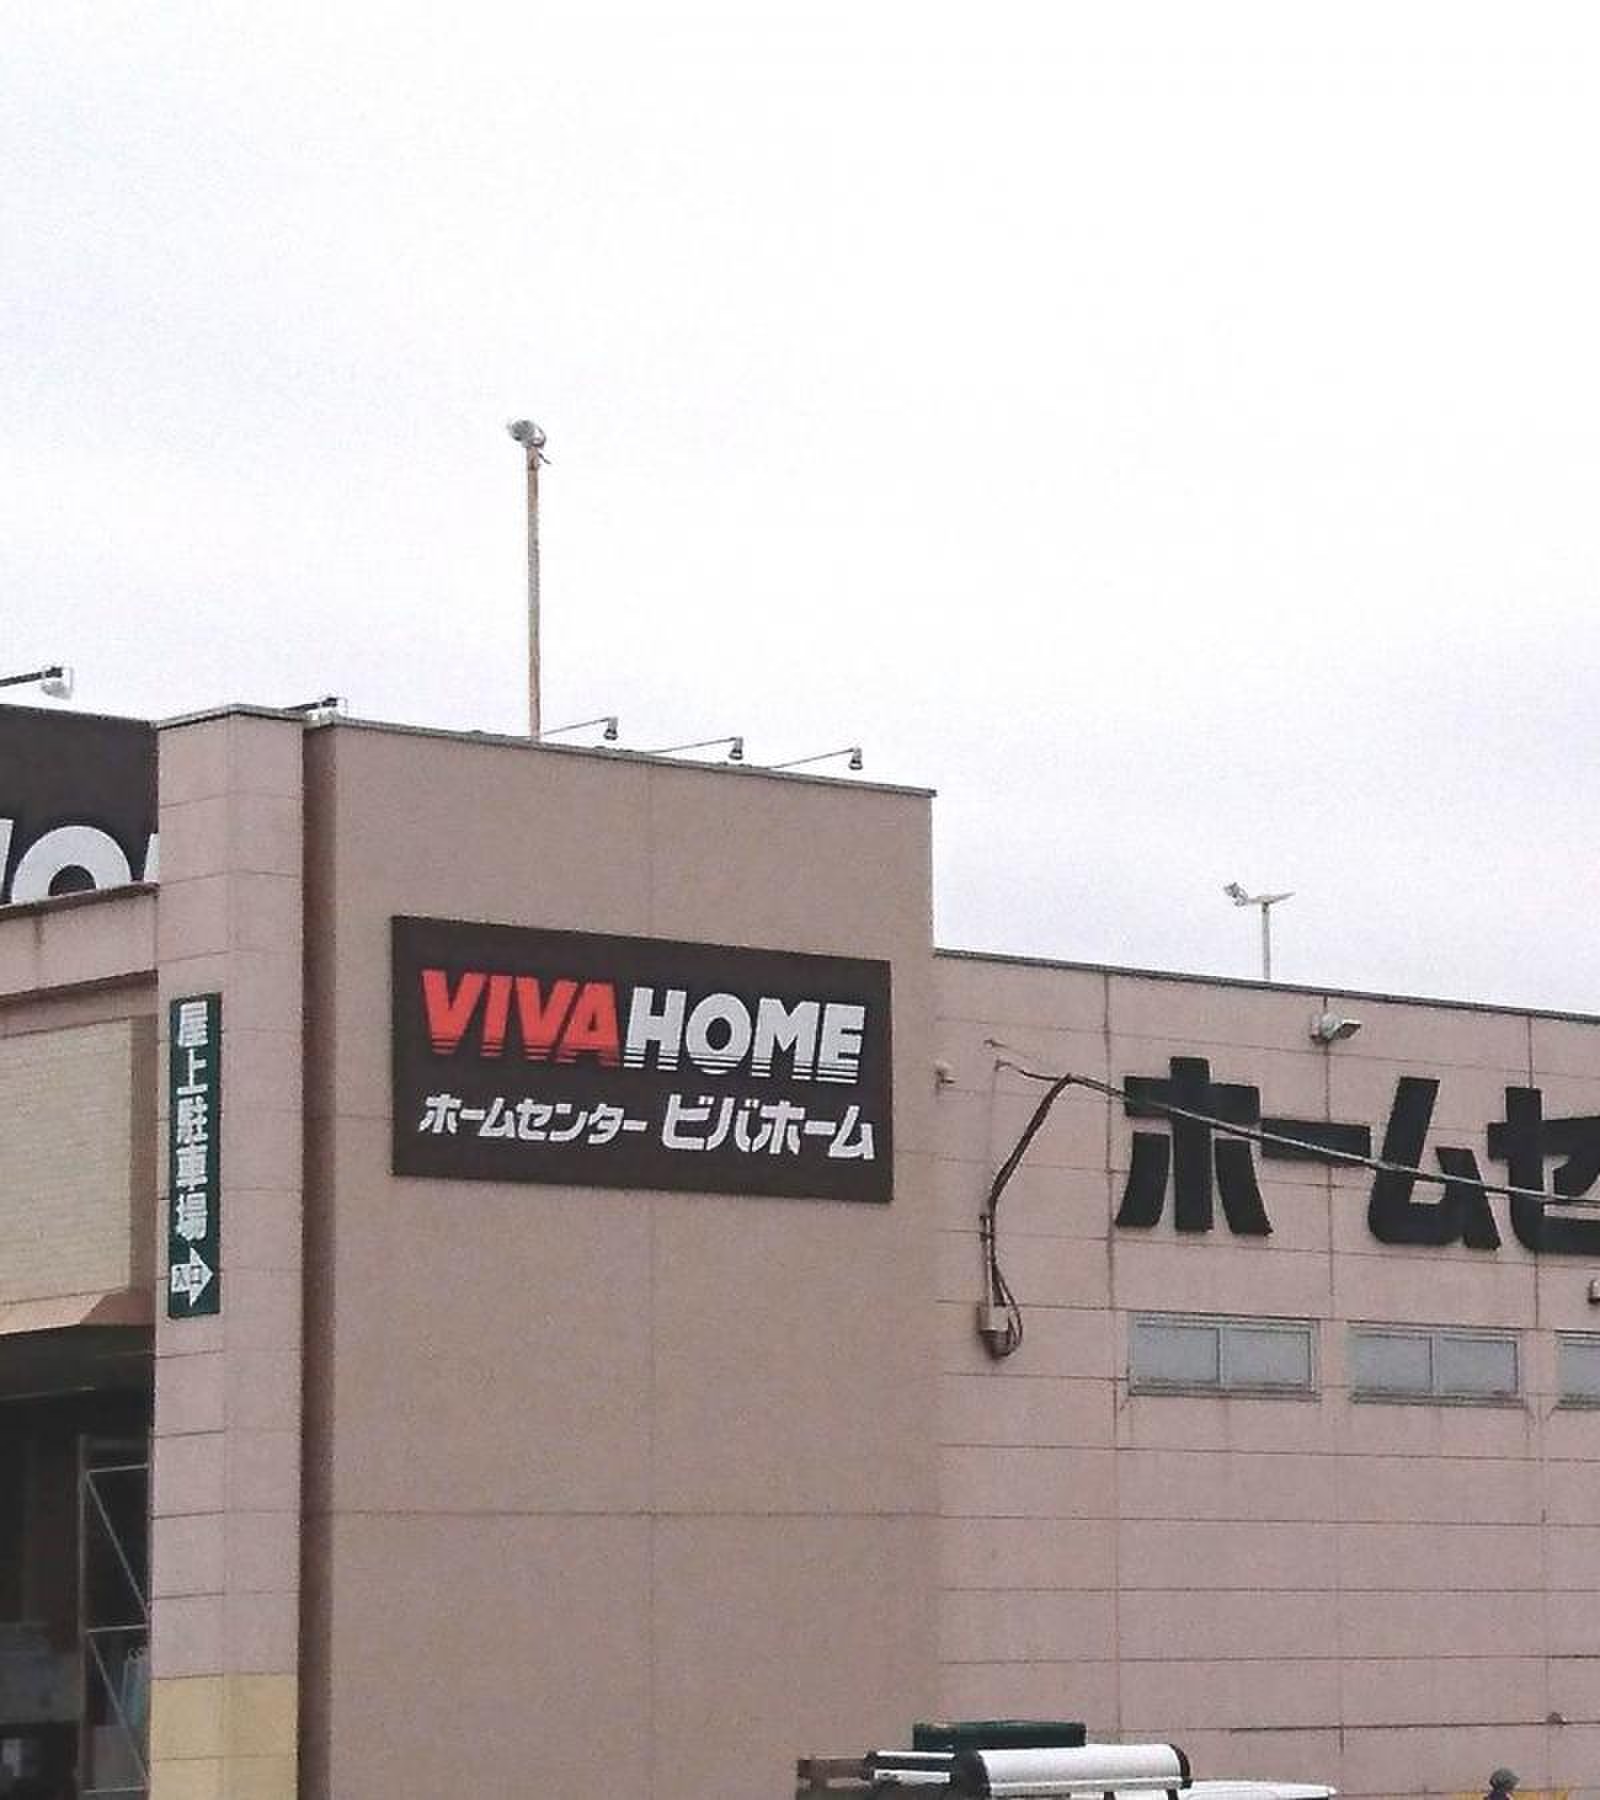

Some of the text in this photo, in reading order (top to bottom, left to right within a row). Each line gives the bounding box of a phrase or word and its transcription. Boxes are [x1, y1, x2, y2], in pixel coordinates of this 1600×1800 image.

[421, 969, 866, 1084] VIVAHOME
[175, 1001, 209, 1241] 屋上駐車場
[418, 1093, 876, 1161] ホームセンター ビバホーム
[174, 1264, 203, 1288] 入口
